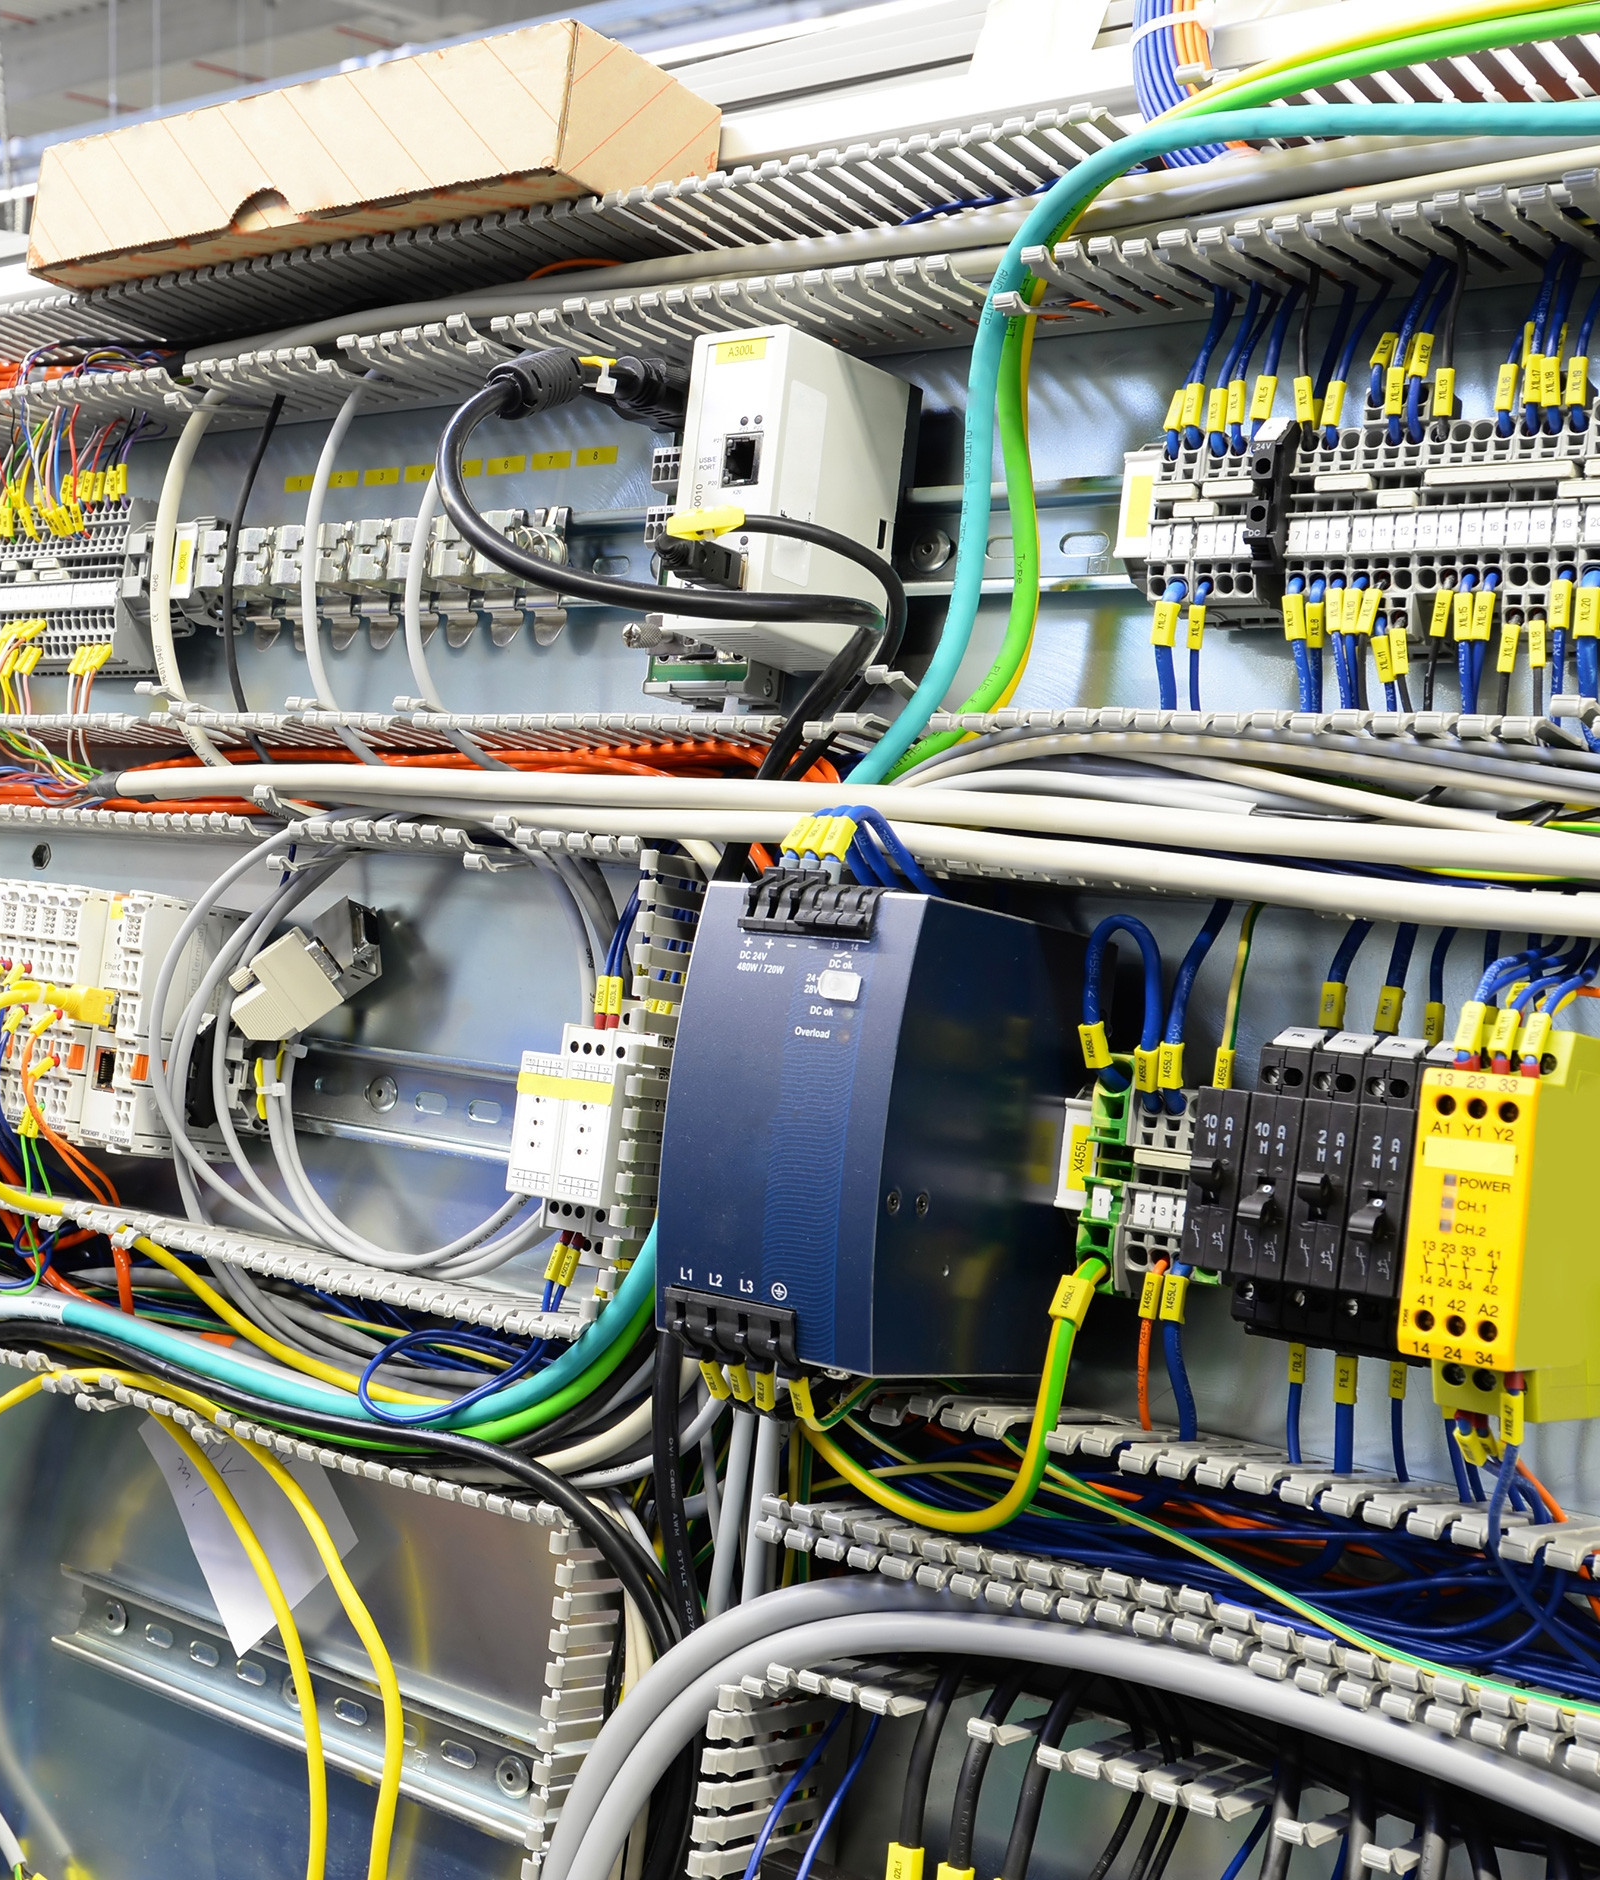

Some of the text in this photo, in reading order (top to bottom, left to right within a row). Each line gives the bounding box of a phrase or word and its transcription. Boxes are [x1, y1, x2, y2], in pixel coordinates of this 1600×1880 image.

[728, 345, 755, 358] A300L
[1254, 443, 1272, 451] 24V
[548, 456, 554, 465] 7
[593, 452, 599, 461] 8
[462, 464, 467, 473] 5
[504, 460, 509, 469] 6
[699, 464, 716, 472] PORT
[380, 472, 385, 481] 3
[420, 468, 426, 477] 4
[298, 479, 302, 487] 1
[338, 476, 343, 484] 2
[1444, 524, 1453, 534] 14
[1468, 523, 1477, 532] 15
[1490, 522, 1499, 532] 16
[1513, 521, 1522, 531] 17
[1536, 520, 1546, 530] 18
[1562, 519, 1572, 529] 19
[1248, 529, 1261, 537] DC
[1295, 531, 1300, 540] 7
[1314, 530, 1320, 539] 8
[1335, 529, 1341, 538] 9
[1358, 529, 1367, 538] 10
[1400, 526, 1409, 536] 12
[1422, 525, 1431, 535] 13
[1017, 553, 1026, 584] Type
[1580, 598, 1592, 621] X1L:20
[831, 942, 839, 950] 13
[740, 950, 768, 961] DC 24V
[737, 962, 785, 974] 480W 720W
[828, 959, 853, 970] DC ok
[810, 1006, 834, 1017] DC ok
[794, 1026, 831, 1039] Overload
[1437, 1072, 1519, 1093] 13 23 33
[48, 1123, 66, 1131] BECKHOFF
[1203, 1113, 1234, 1132] 10 A
[81, 1129, 100, 1137] BECKHOFF
[1254, 1122, 1287, 1140] 10 A
[1432, 1122, 1515, 1142] A1 Y1 Y2
[1207, 1132, 1232, 1149] M 1
[1318, 1129, 1346, 1147] 2 A
[1260, 1140, 1284, 1157] M 1
[1372, 1135, 1401, 1153] 2 A
[1074, 1140, 1088, 1173] X455L
[1316, 1148, 1342, 1165] M 1
[1371, 1154, 1398, 1171] M 1
[1459, 1177, 1512, 1193] POWER
[1140, 1204, 1166, 1217] 2 3
[1457, 1200, 1487, 1214] CH.1
[1455, 1223, 1487, 1237] CH.2
[1422, 1240, 1501, 1260] 13 23 33 41
[680, 1267, 754, 1293] L1 L2 L3
[1420, 1275, 1499, 1296] 14 24 34 42
[1417, 1294, 1499, 1318] 41 42 A2
[1412, 1341, 1494, 1366] 14 24 34
[672, 1513, 680, 1537] AWM
[676, 1550, 687, 1588] STYLE
